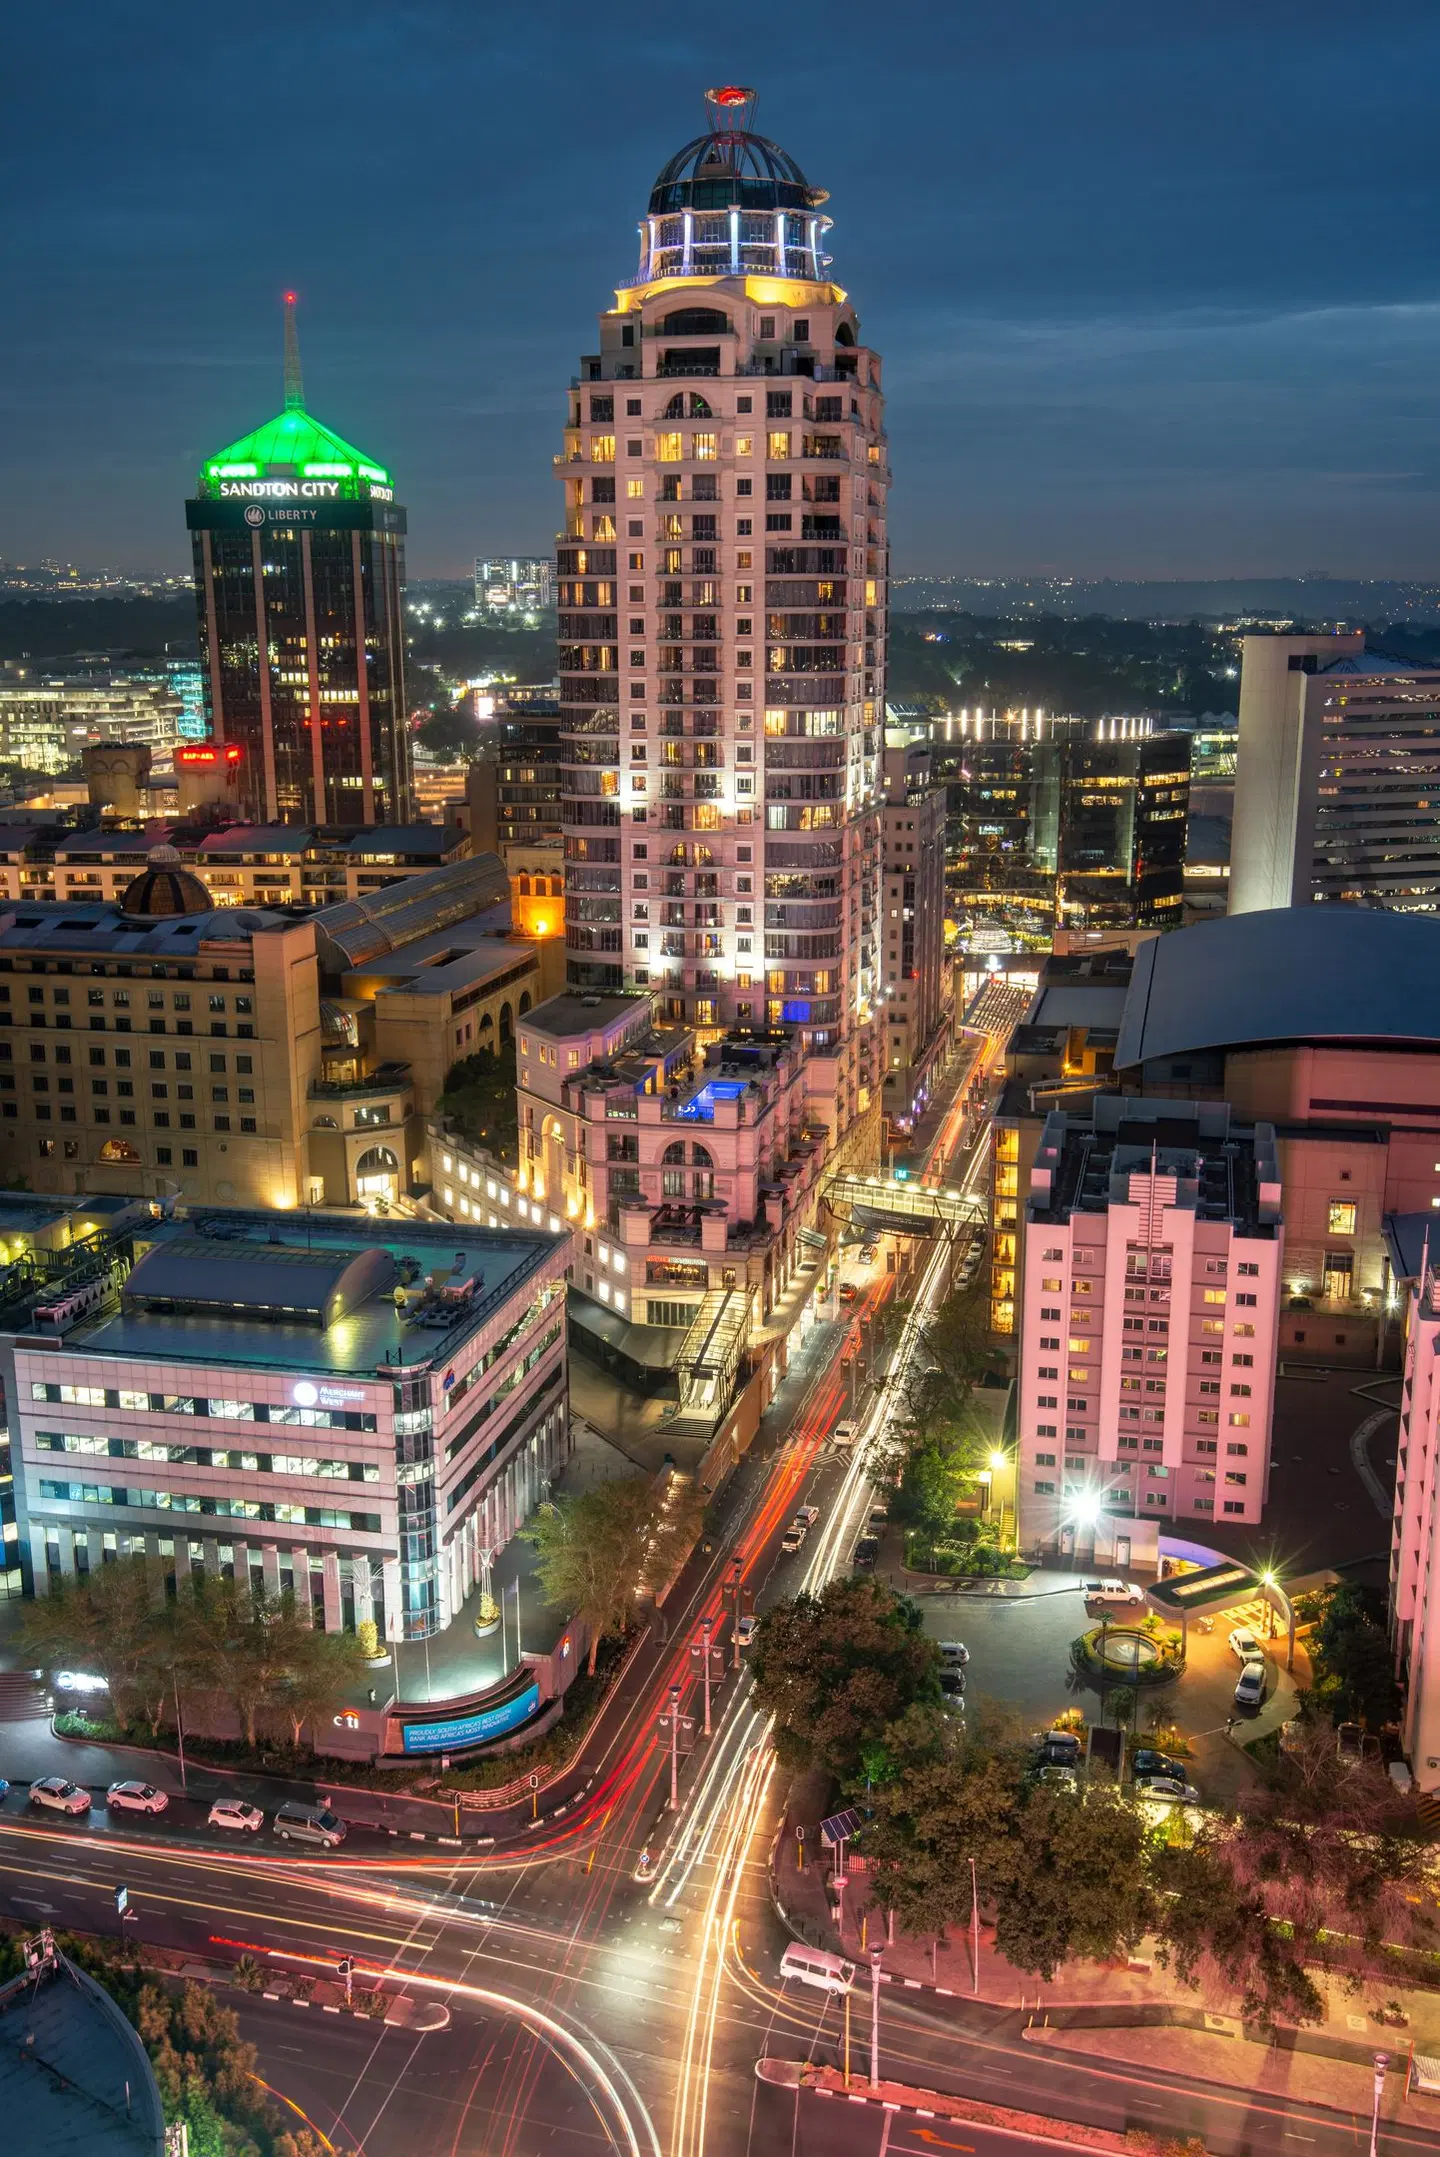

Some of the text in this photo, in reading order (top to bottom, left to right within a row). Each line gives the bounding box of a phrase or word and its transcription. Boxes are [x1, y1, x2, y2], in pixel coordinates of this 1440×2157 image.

[220, 482, 339, 497] SANDTON CITY
[268, 509, 317, 520] LIBERTY
[333, 1711, 359, 1729] cti
[437, 1725, 458, 1734] SOUTH
[482, 1717, 495, 1726] BEST
[426, 1733, 440, 1741] AND
[465, 1727, 482, 1735] MOST
